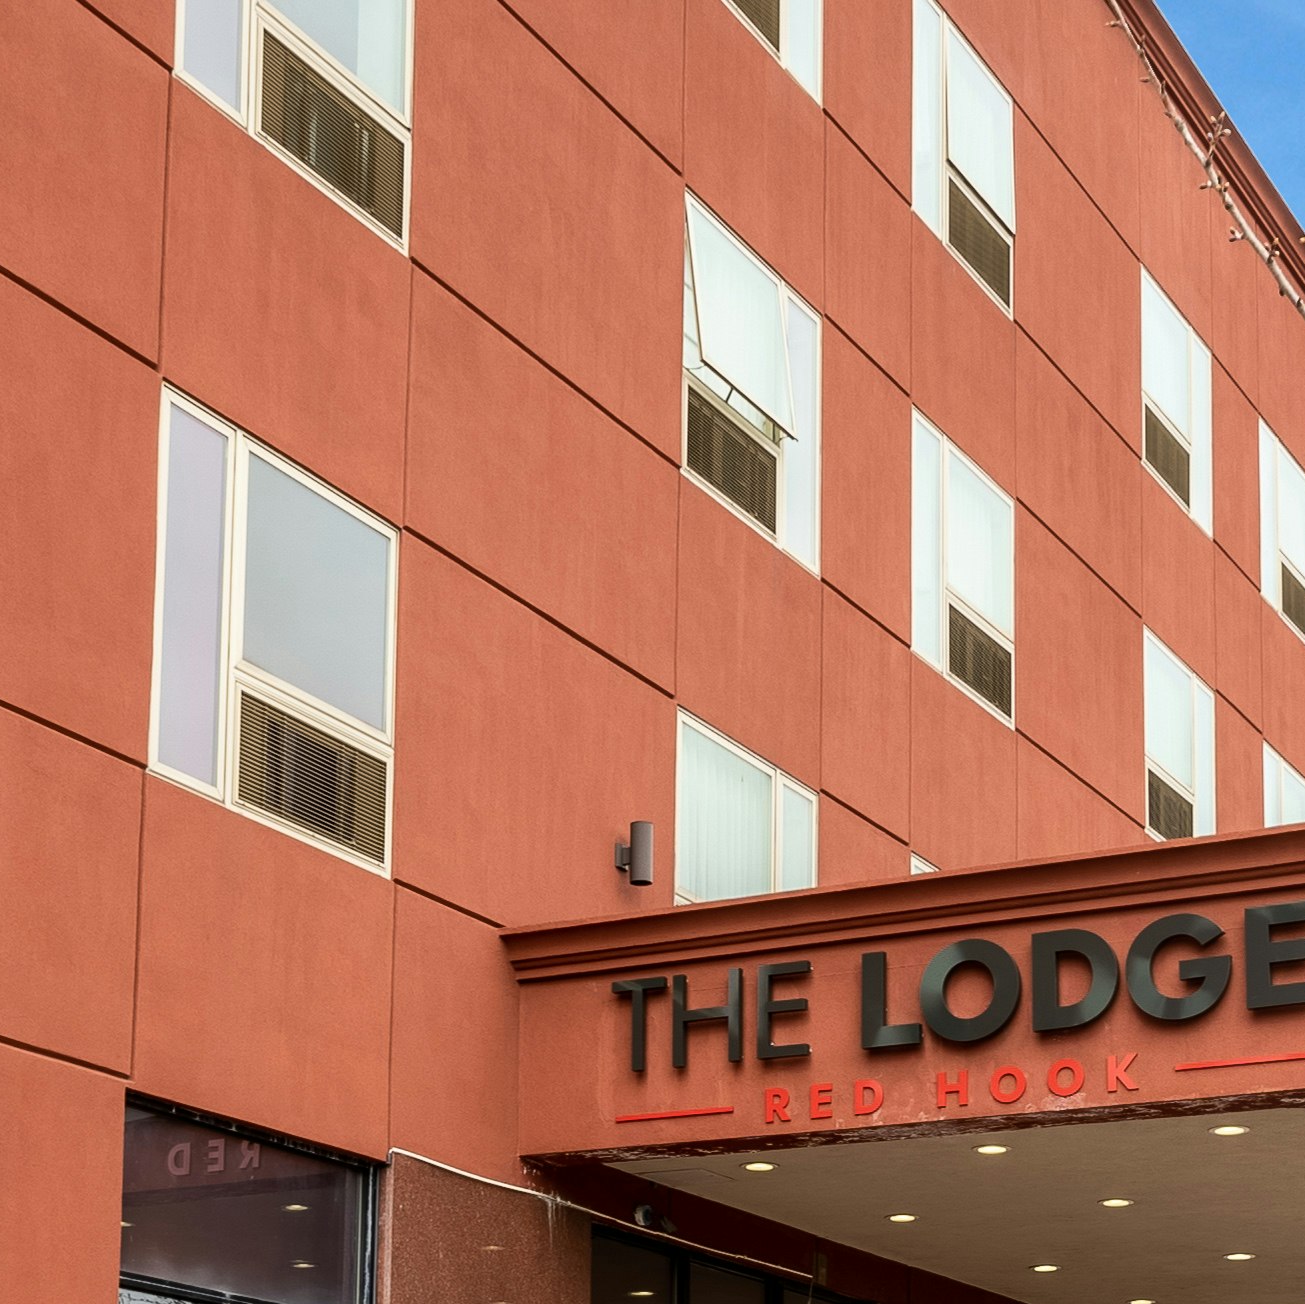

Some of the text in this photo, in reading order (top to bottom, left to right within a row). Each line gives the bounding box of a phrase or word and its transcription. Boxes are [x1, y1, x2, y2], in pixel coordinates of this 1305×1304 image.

[611, 960, 812, 1072] THE
[764, 1052, 1140, 1123] RED HOOK
